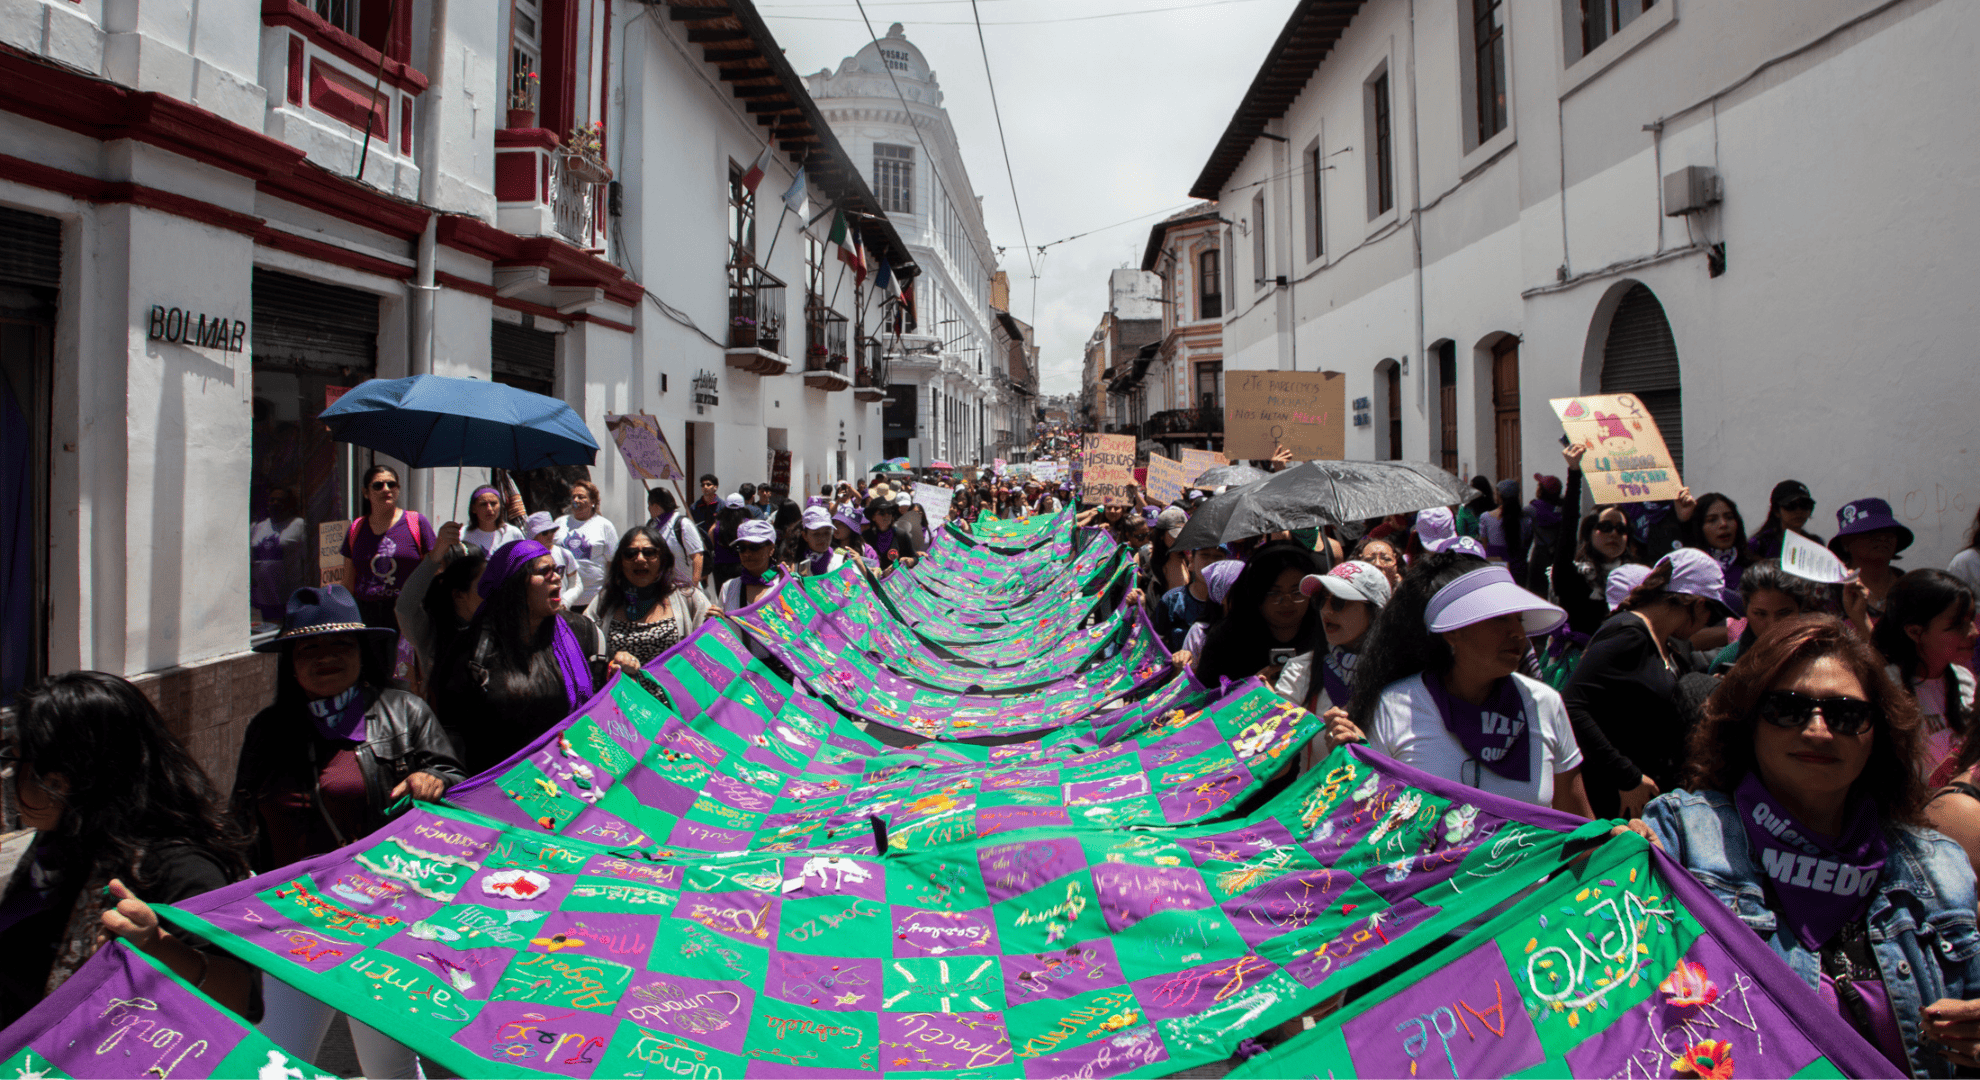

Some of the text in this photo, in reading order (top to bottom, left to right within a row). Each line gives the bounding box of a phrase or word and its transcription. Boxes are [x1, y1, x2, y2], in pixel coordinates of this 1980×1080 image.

[148, 304, 246, 353] BOLMAR
[1084, 451, 1136, 468] HISTERICAS
[1085, 436, 1100, 450] NO
[1751, 801, 1821, 855] Quiero
[1761, 847, 1879, 898] MIEDO
[763, 1013, 863, 1050] Gabriela
